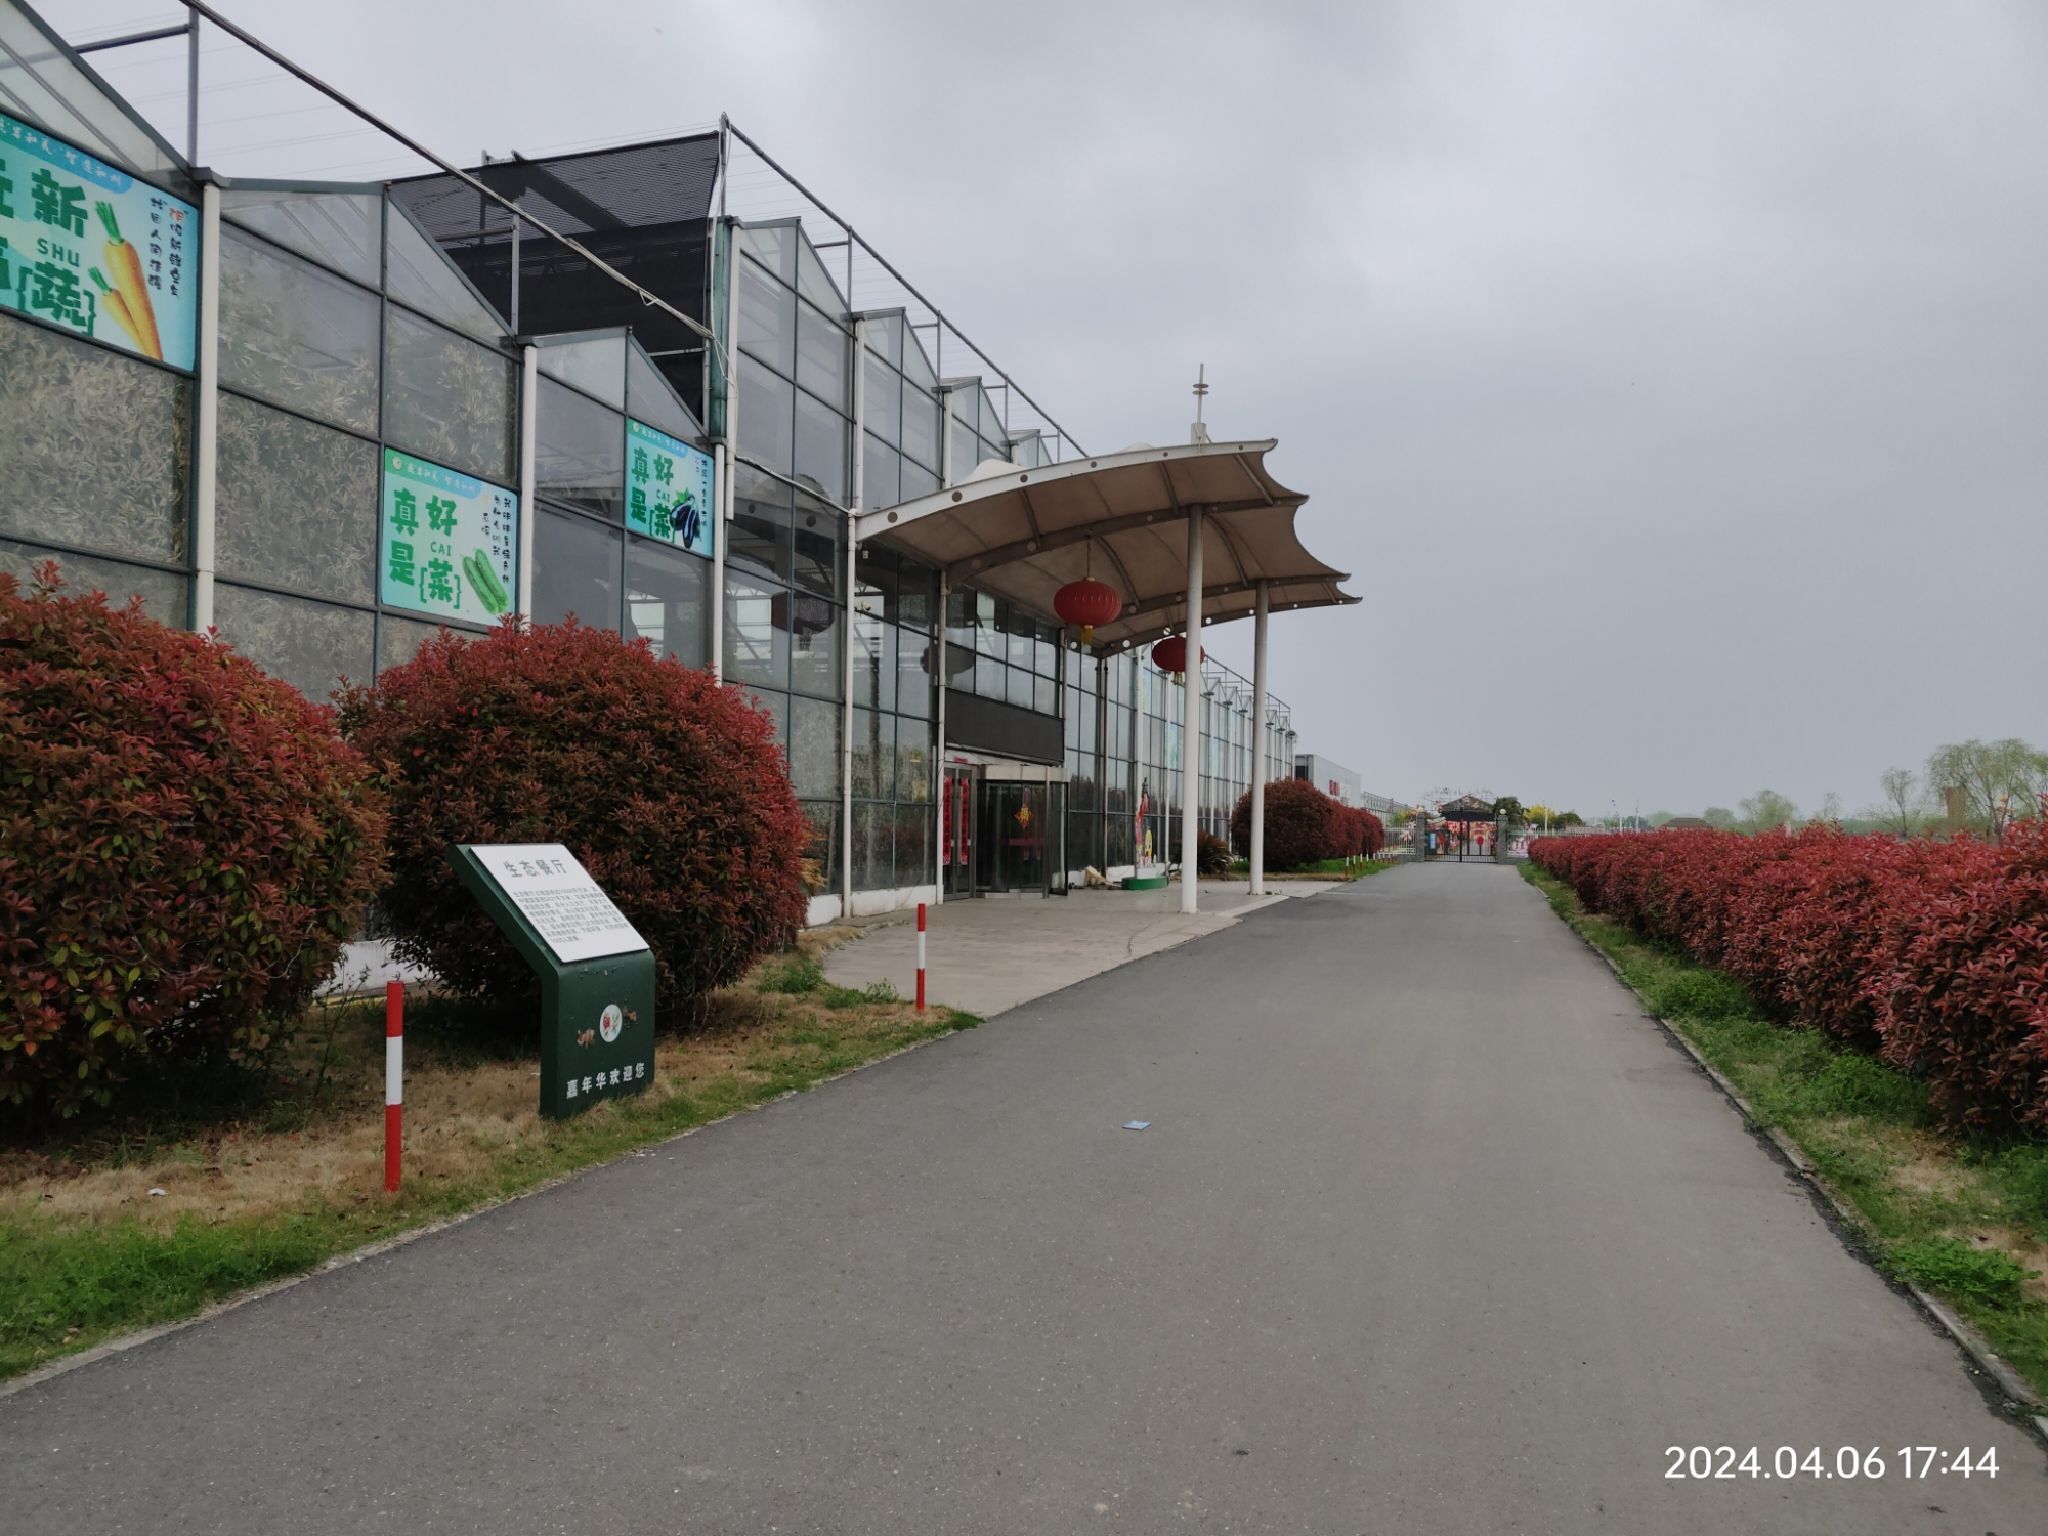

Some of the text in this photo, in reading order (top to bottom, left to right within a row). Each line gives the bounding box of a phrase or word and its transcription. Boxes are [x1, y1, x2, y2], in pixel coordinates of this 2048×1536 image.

[37, 238, 81, 268] SHU
[632, 446, 674, 486] 真好
[390, 487, 458, 537] 真好
[431, 541, 452, 557] CAI
[504, 859, 568, 878] 生态餐厅
[566, 1062, 645, 1099] 嘉年华欢迎您
